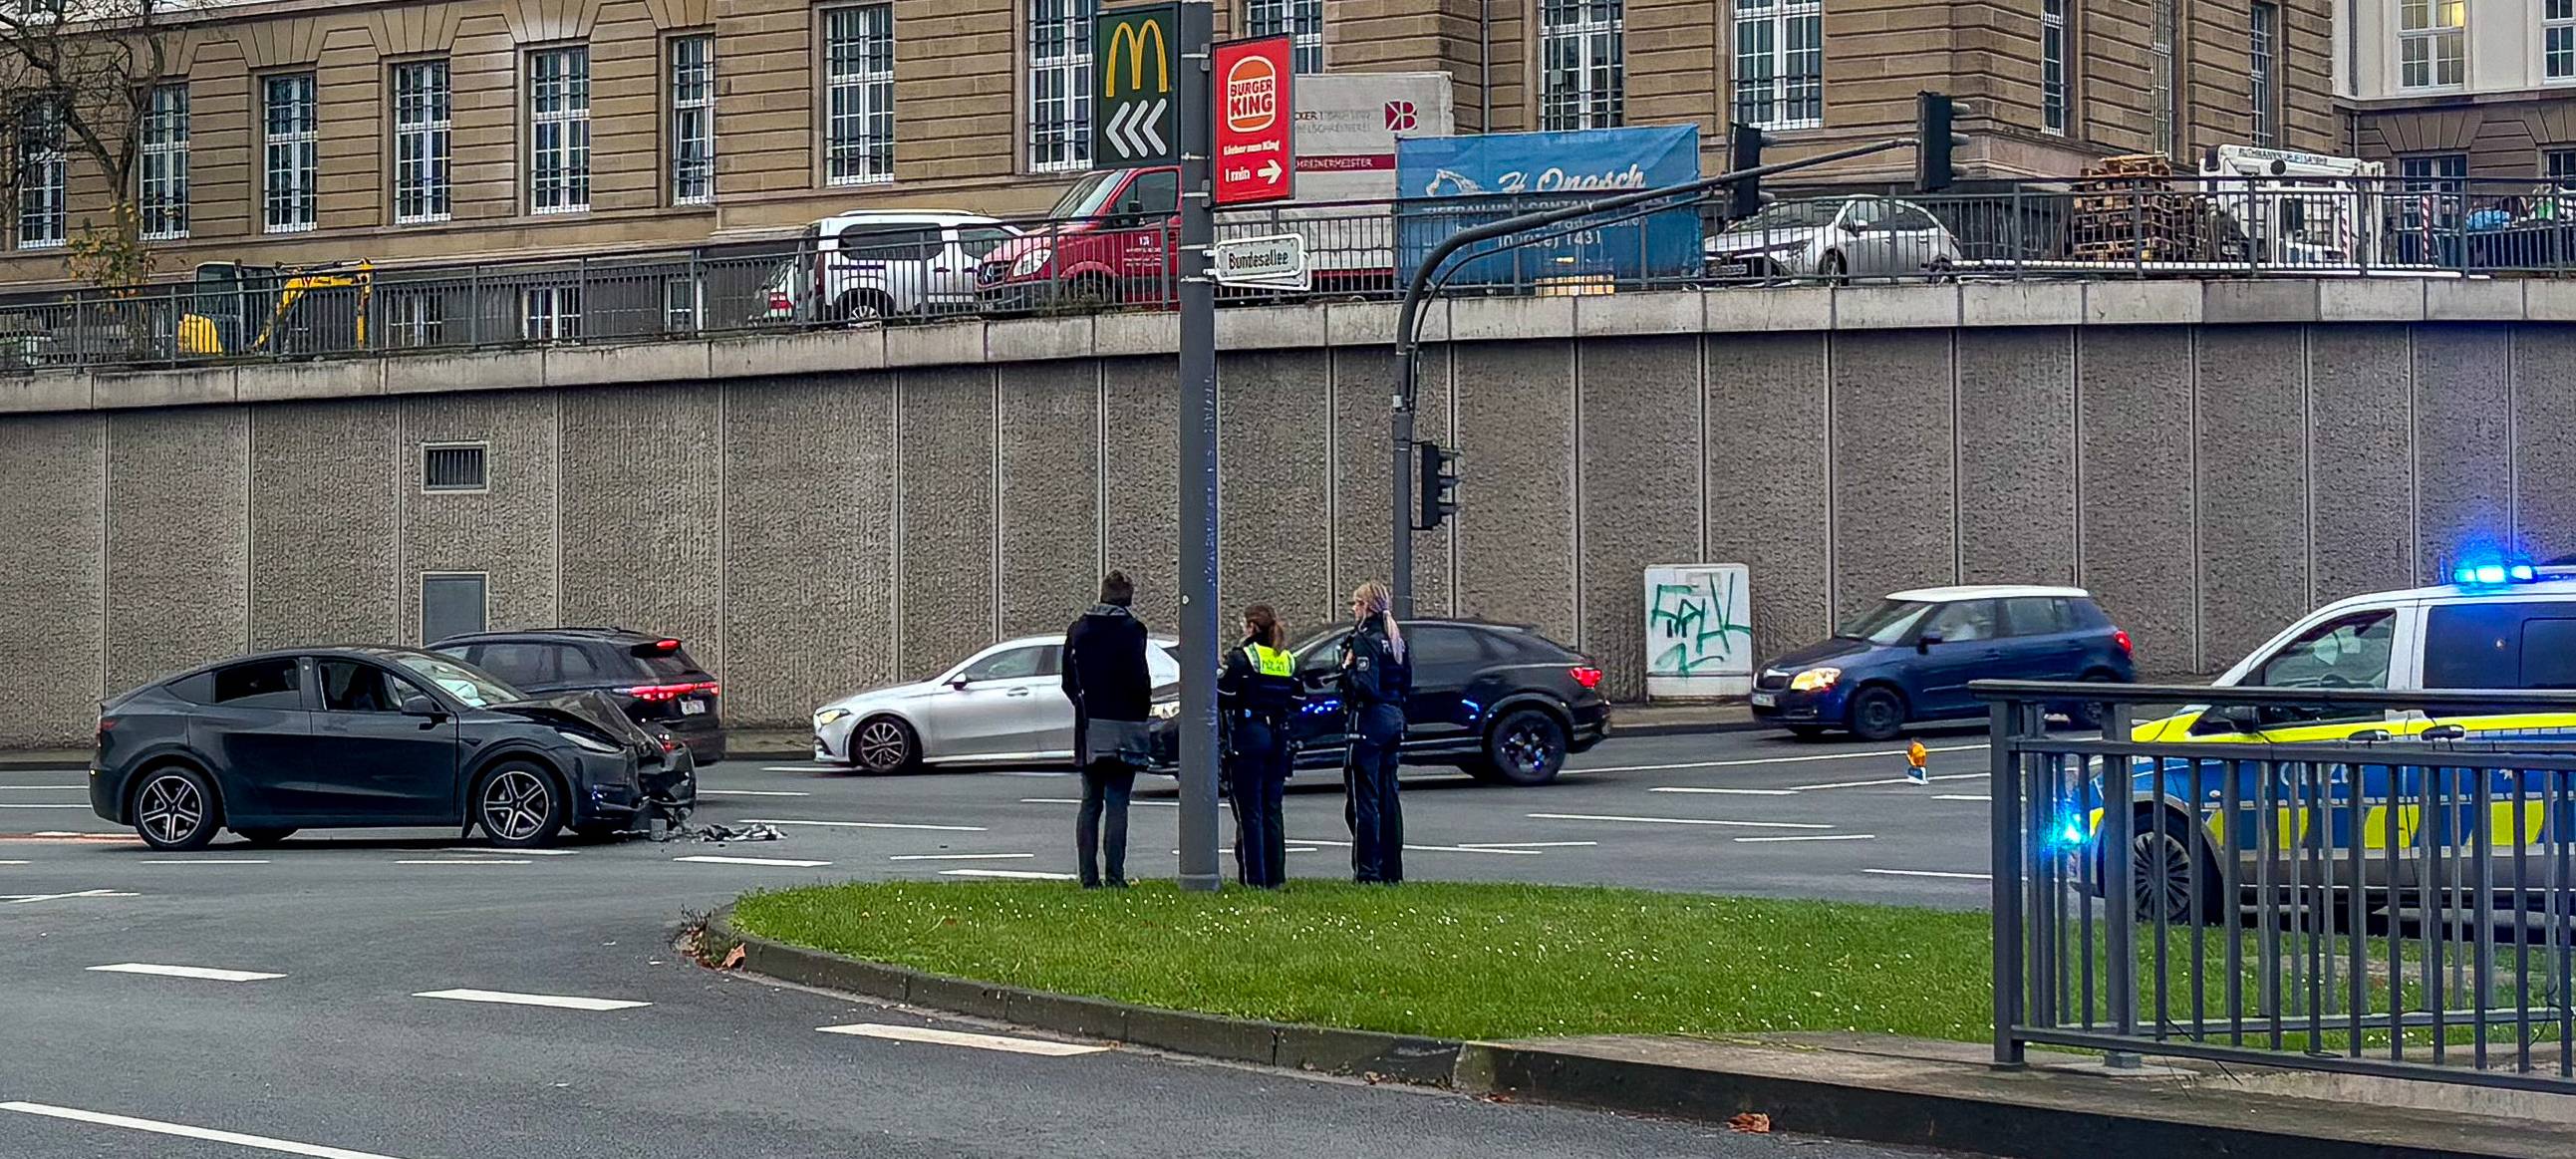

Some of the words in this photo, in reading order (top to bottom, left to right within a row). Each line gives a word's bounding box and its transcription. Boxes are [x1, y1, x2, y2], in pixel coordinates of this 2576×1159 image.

[1230, 78, 1273, 97] BURGER
[1230, 94, 1273, 118] KING
[1230, 165, 1251, 181] min
[1228, 248, 1289, 270] Bundesallee
